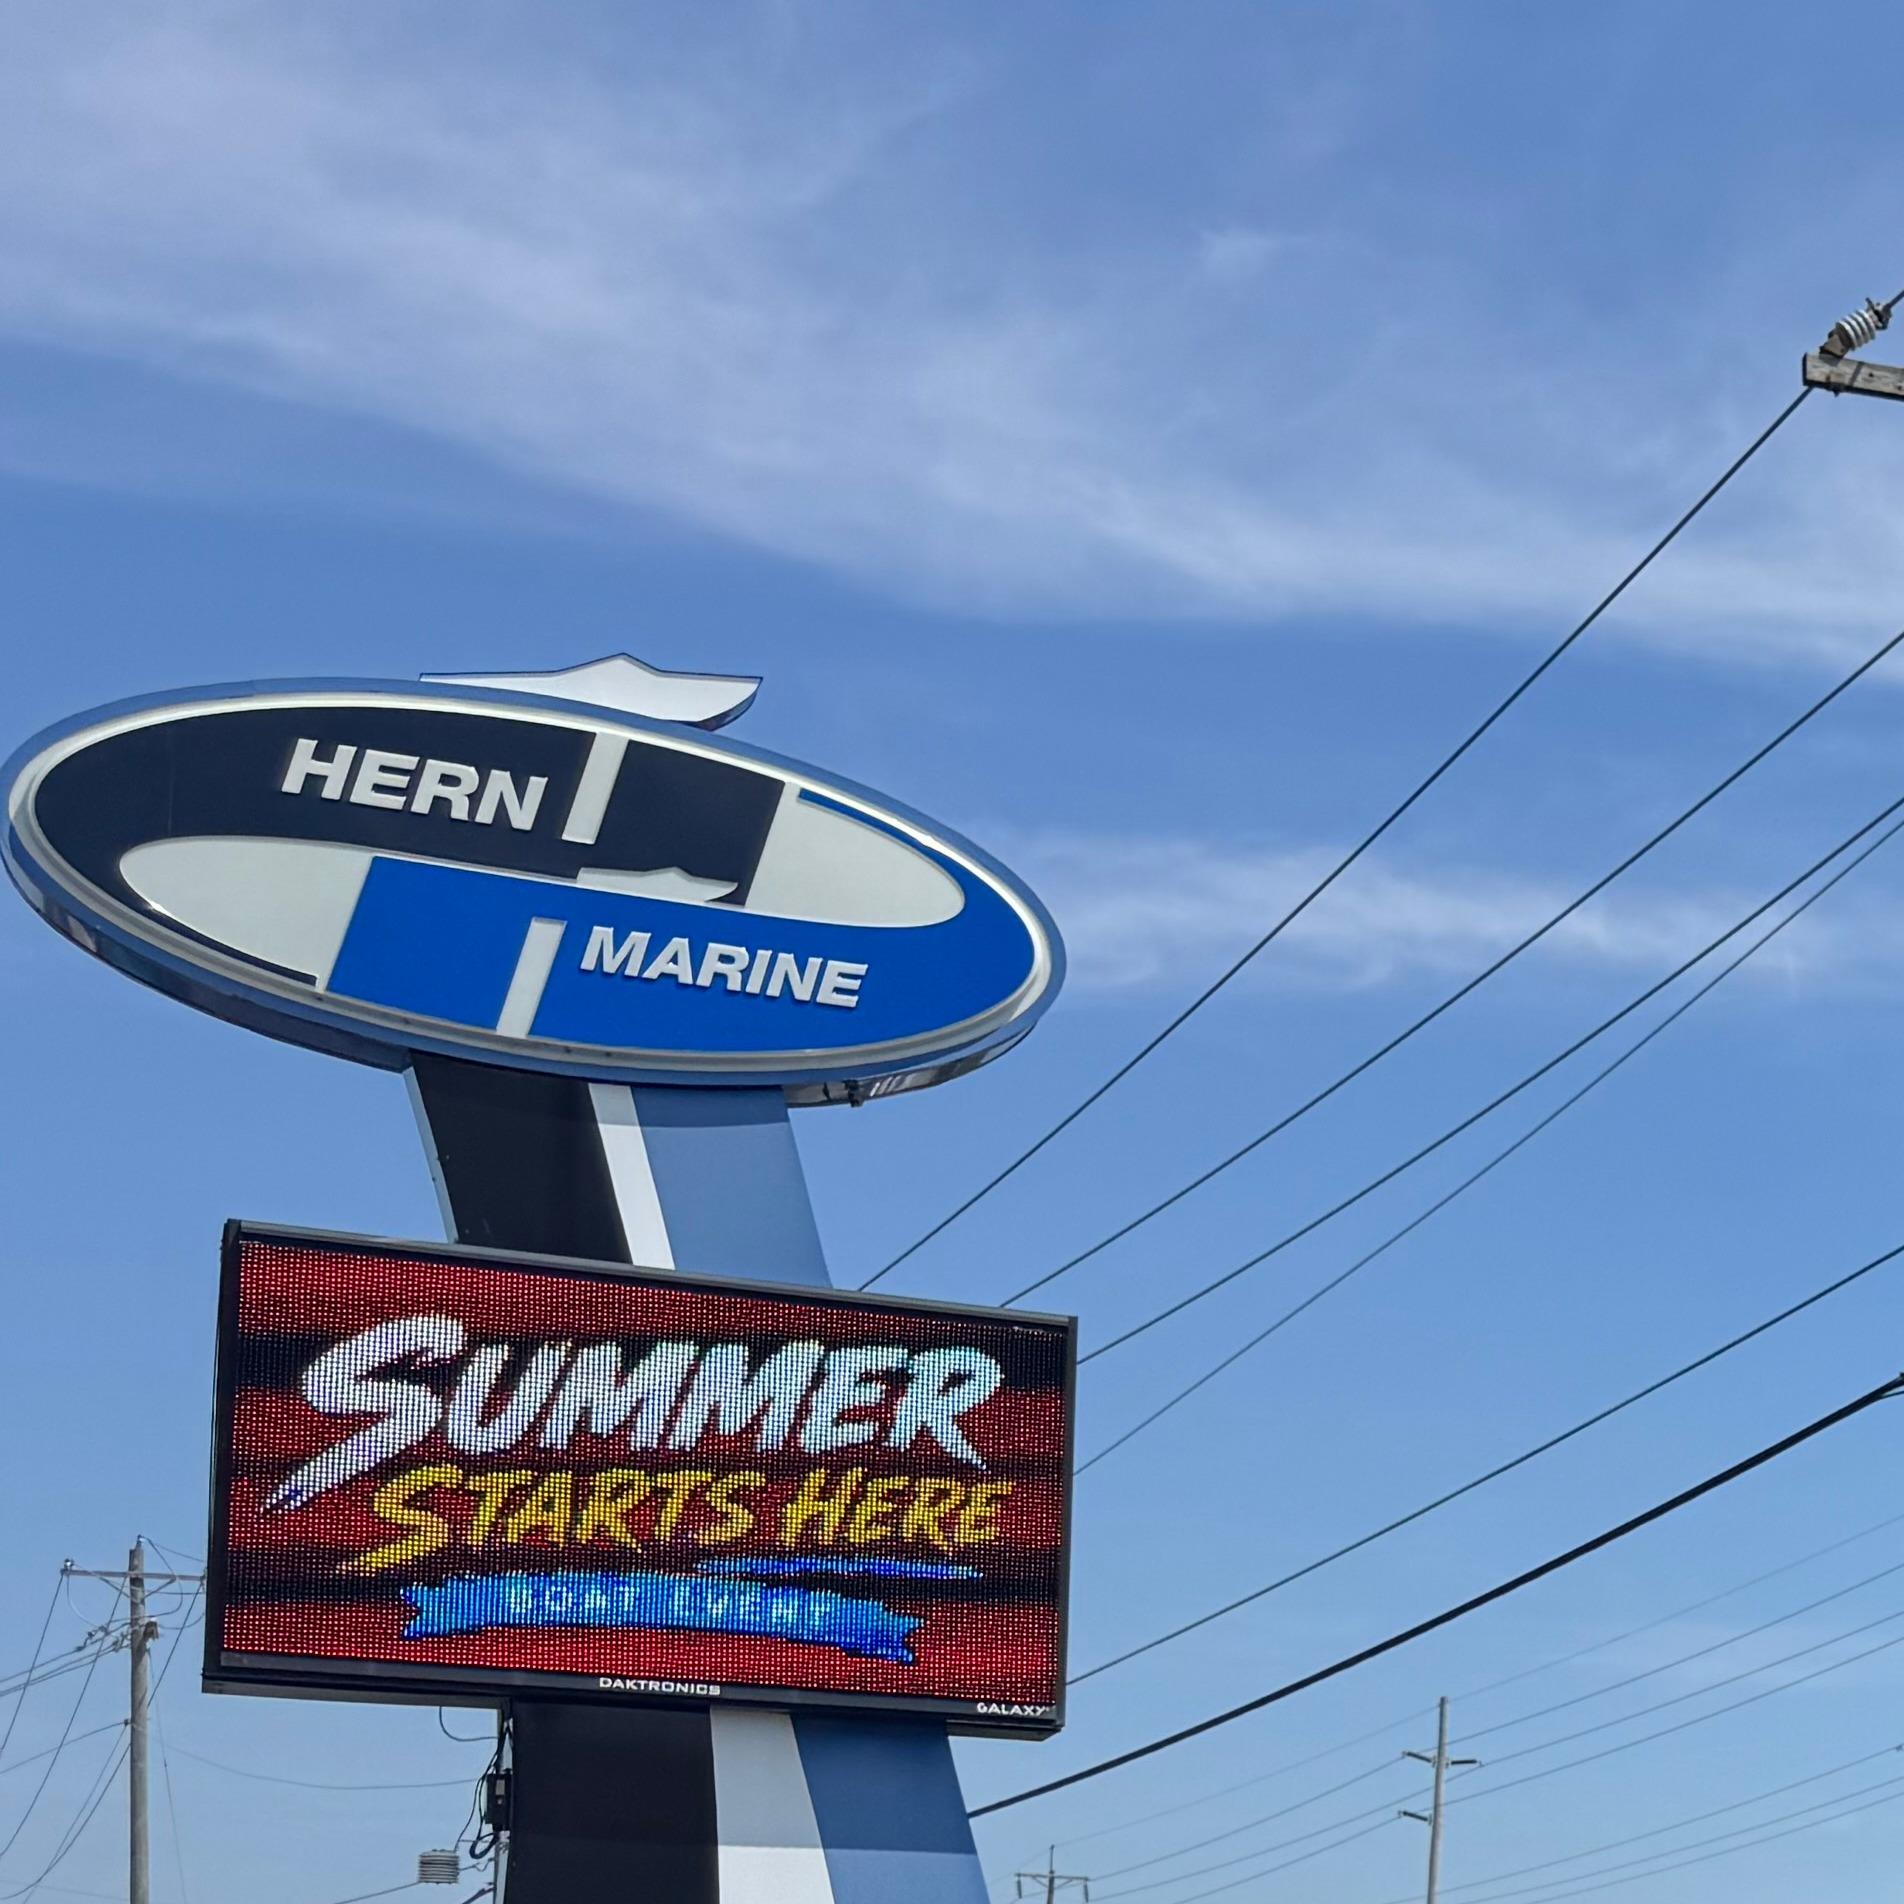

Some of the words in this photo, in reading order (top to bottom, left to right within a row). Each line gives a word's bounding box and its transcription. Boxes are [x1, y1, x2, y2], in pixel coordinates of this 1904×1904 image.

[281, 737, 549, 831] HERN
[579, 925, 869, 1009] MARINE
[260, 1312, 1004, 1514] SUMMER
[337, 1464, 767, 1578] STARTS
[779, 1466, 1015, 1554] HERE
[509, 1584, 641, 1614] BOAT
[673, 1586, 834, 1627] EVENT
[599, 1677, 721, 1695] DAKTRONICS
[976, 1701, 1044, 1717] GALAXY
